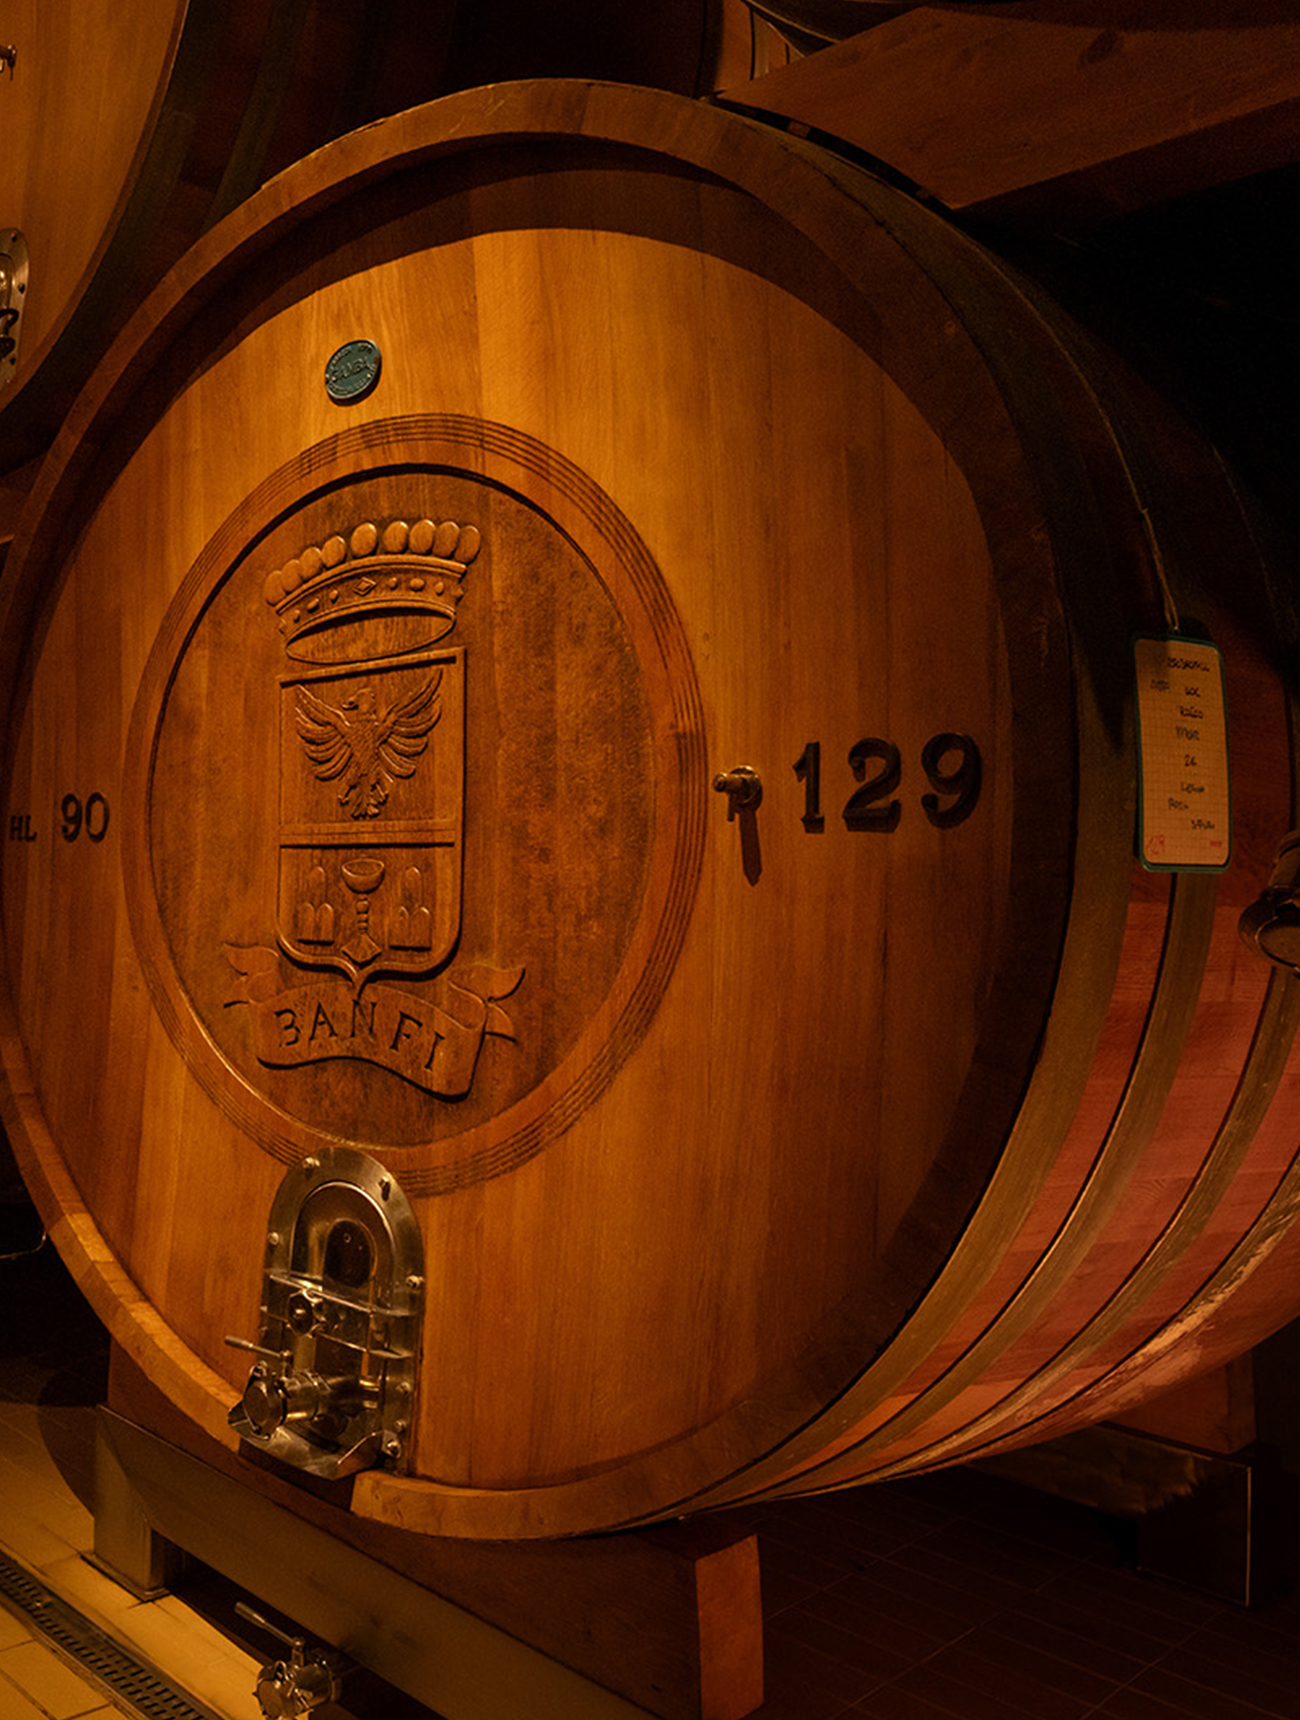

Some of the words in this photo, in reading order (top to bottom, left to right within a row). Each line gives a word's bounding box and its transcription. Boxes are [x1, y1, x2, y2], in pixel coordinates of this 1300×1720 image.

[10, 814, 37, 841] HL
[62, 792, 110, 842] 90
[792, 732, 982, 834] 129
[274, 999, 445, 1070] BANFI
